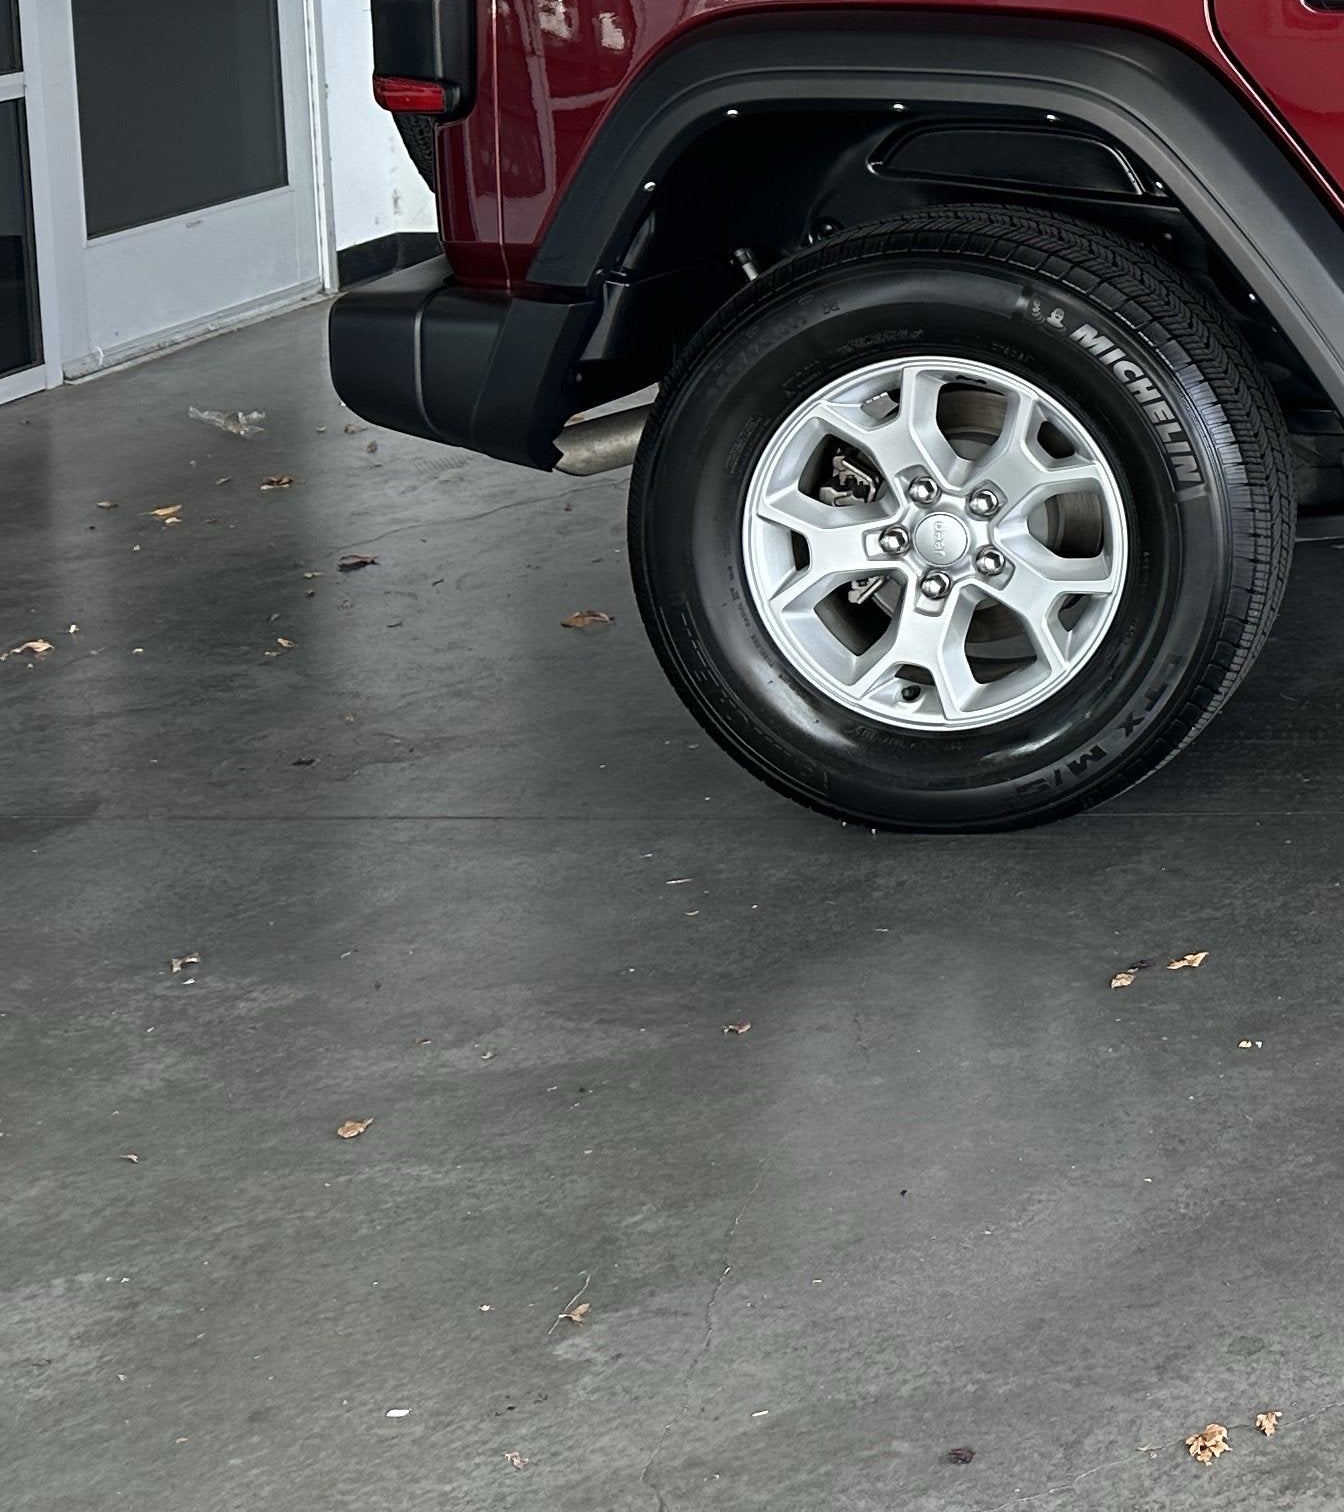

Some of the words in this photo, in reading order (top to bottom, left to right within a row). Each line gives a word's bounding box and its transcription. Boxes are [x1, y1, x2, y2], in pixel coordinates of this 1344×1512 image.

[1069, 323, 1204, 483] MICHELIN
[932, 520, 946, 558] Jeep
[1114, 651, 1187, 738] LTX
